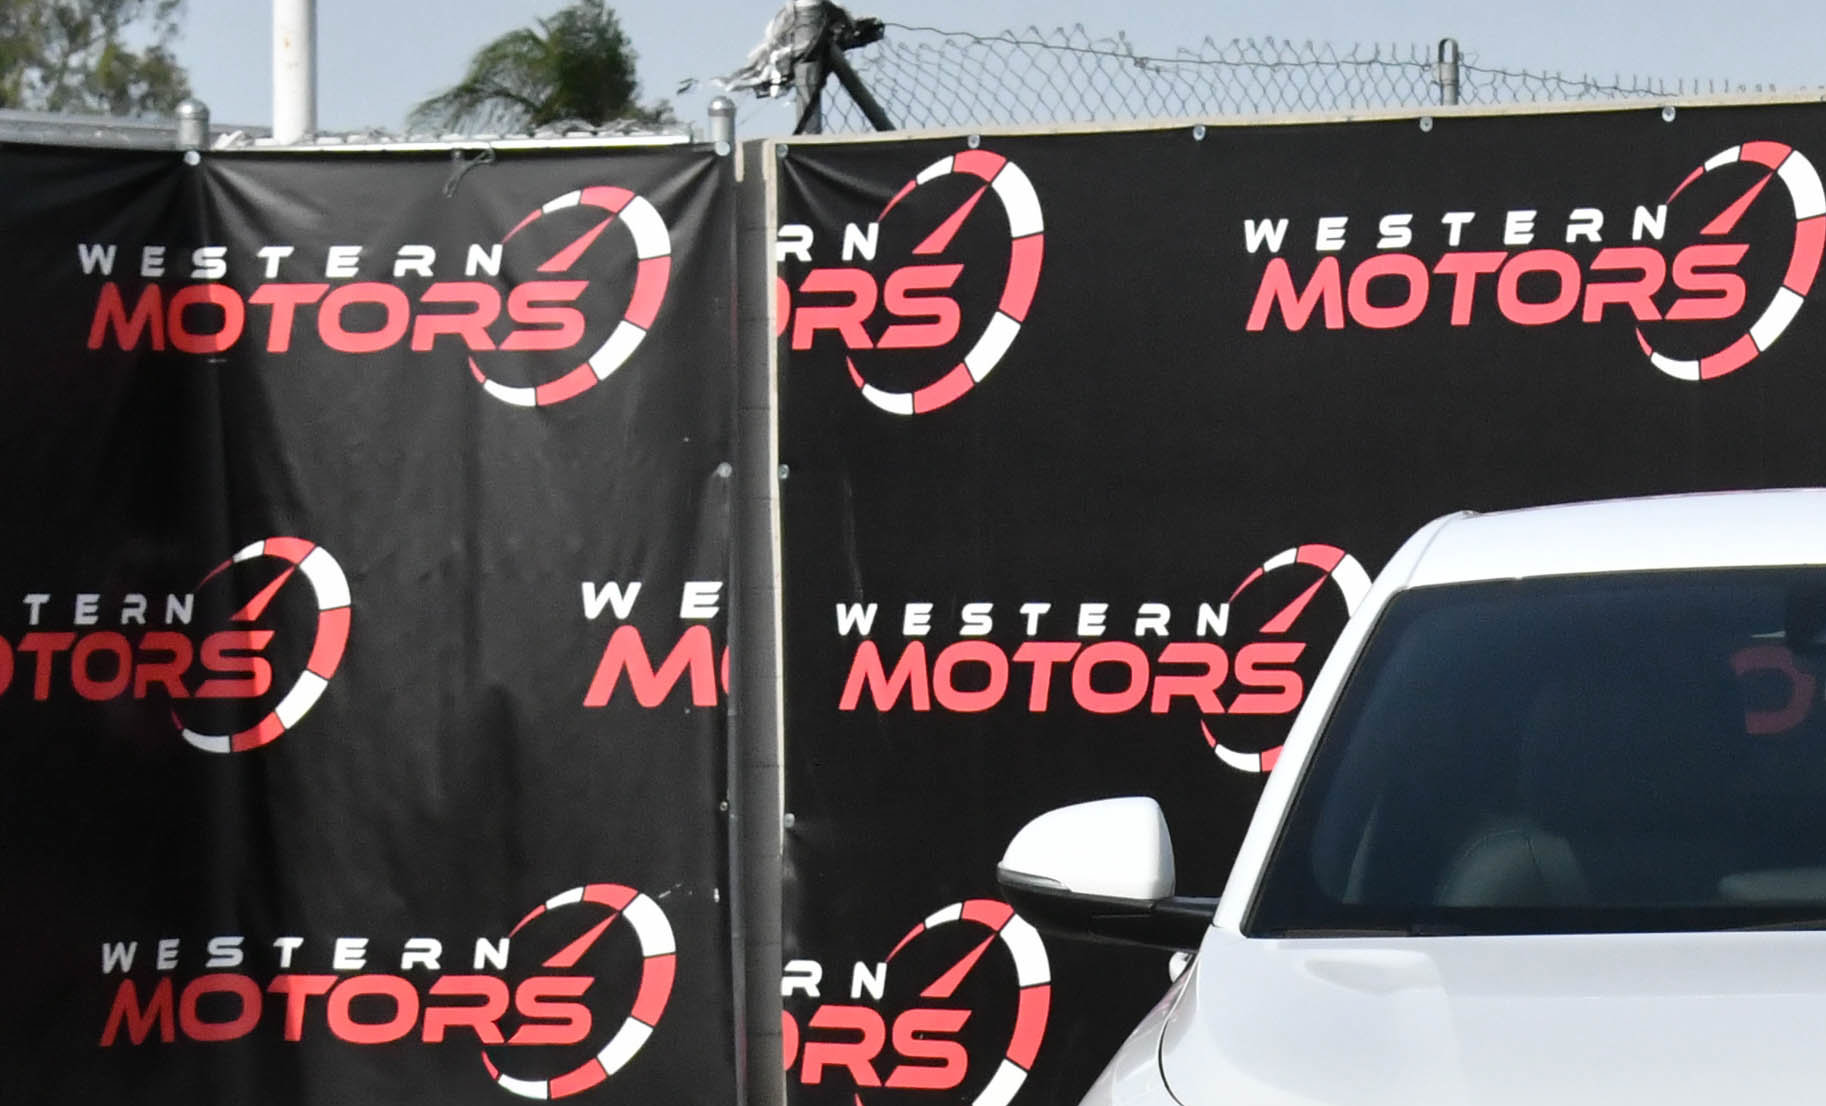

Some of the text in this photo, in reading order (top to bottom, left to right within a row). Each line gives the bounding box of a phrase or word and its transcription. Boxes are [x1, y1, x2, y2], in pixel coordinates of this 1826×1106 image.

[78, 243, 503, 278] WESTERN
[1243, 204, 1668, 253] WESTERN
[87, 280, 590, 354] MOTORS
[776, 263, 966, 350] RS
[1244, 243, 1751, 332] MOTORS
[581, 581, 724, 620] WE
[835, 603, 1230, 636] WESTERN
[0, 629, 276, 701] TORS
[583, 624, 731, 709] M
[837, 639, 1308, 715] MOTORS
[103, 936, 511, 974] WESTERN
[100, 973, 596, 1046] MOTORS
[782, 1004, 973, 1090] RS
